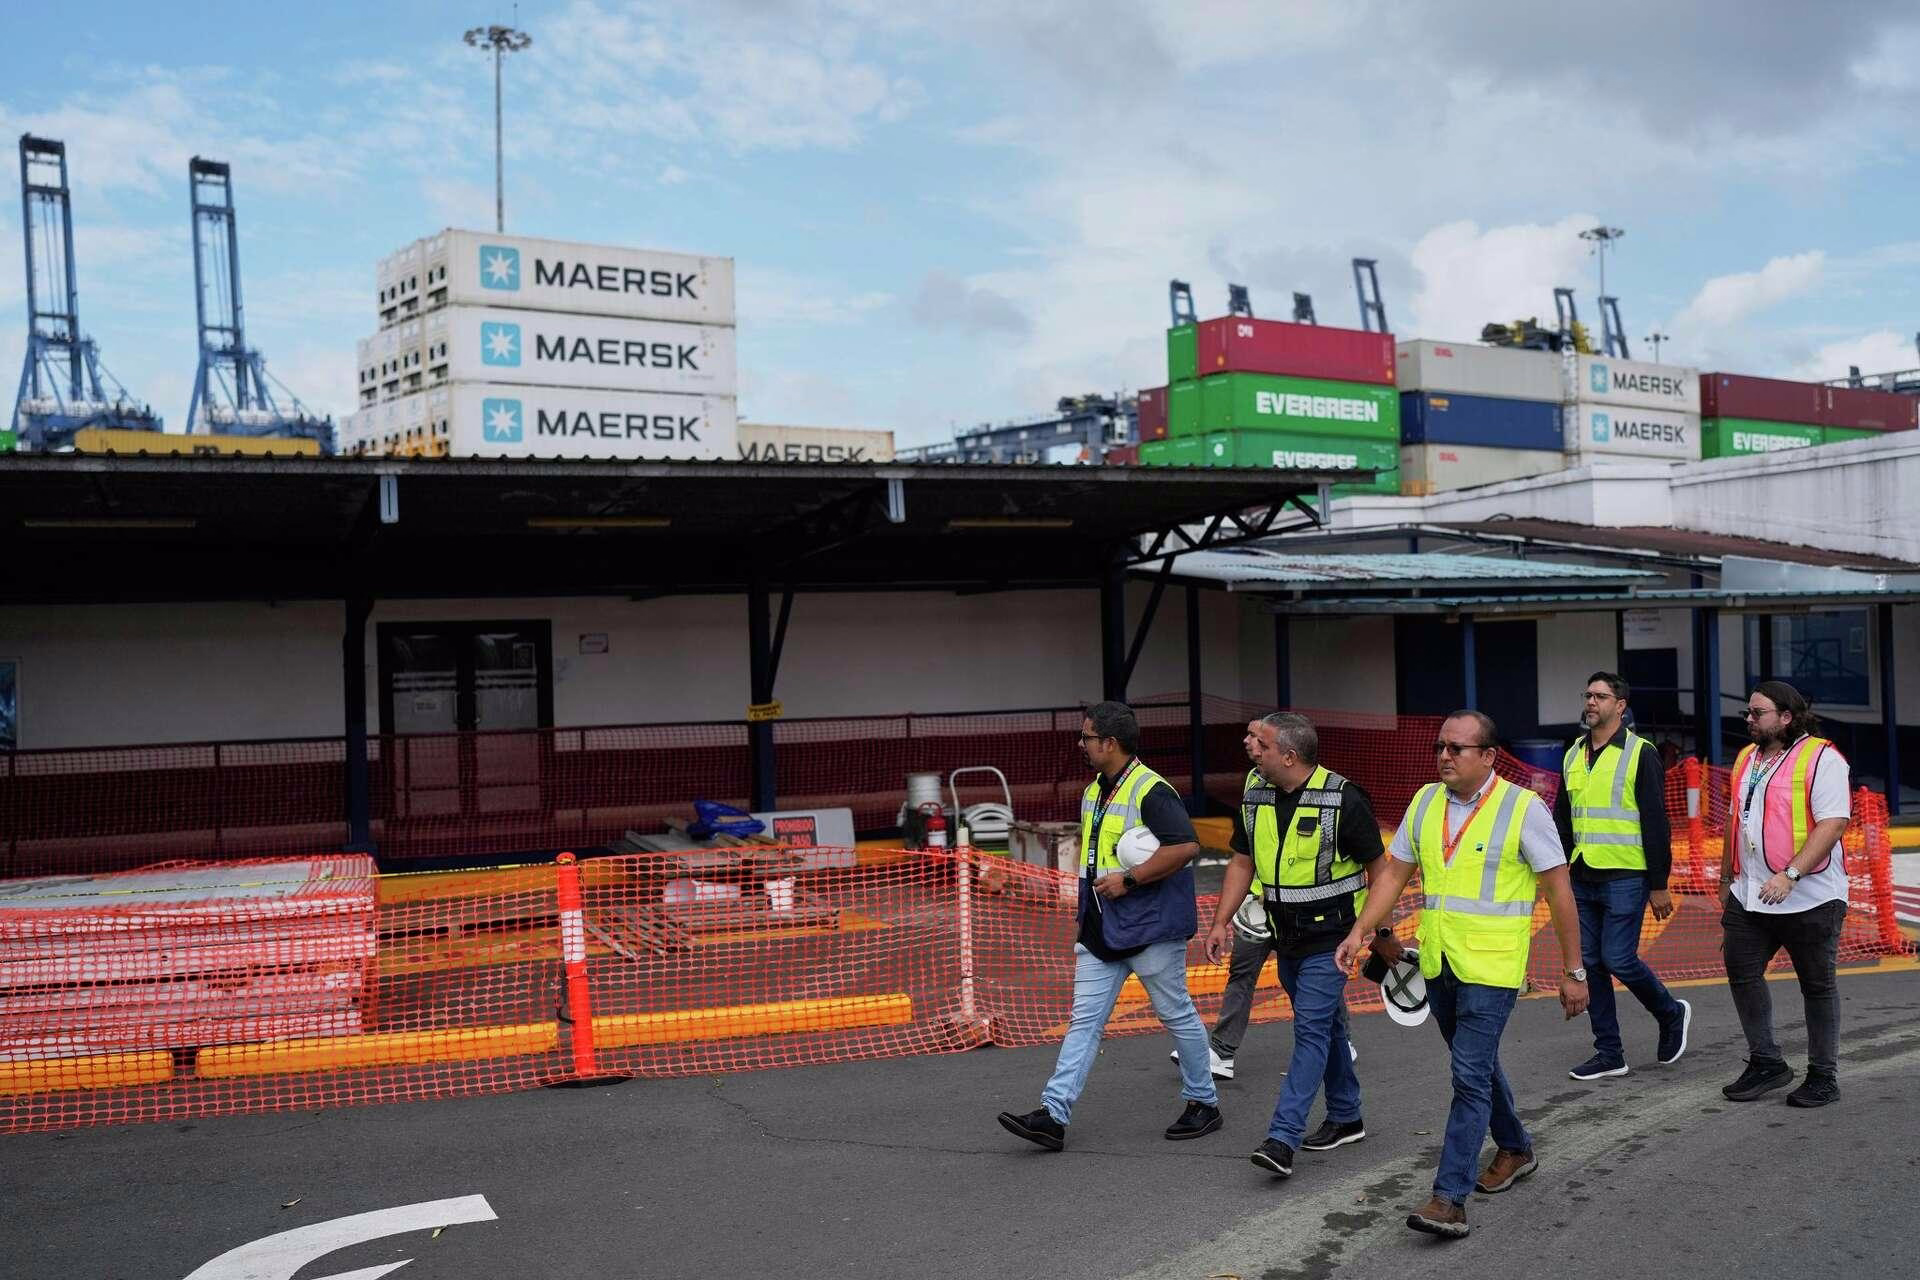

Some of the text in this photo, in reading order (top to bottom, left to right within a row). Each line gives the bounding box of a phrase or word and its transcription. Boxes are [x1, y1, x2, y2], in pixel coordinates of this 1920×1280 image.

[534, 258, 698, 299] MAERSK
[536, 334, 699, 371] MAERSK
[1613, 372, 1684, 396] MAERSK
[1256, 391, 1379, 422] EVERGREEN
[537, 409, 701, 442] MAERSK
[1614, 421, 1685, 443] MAERSK
